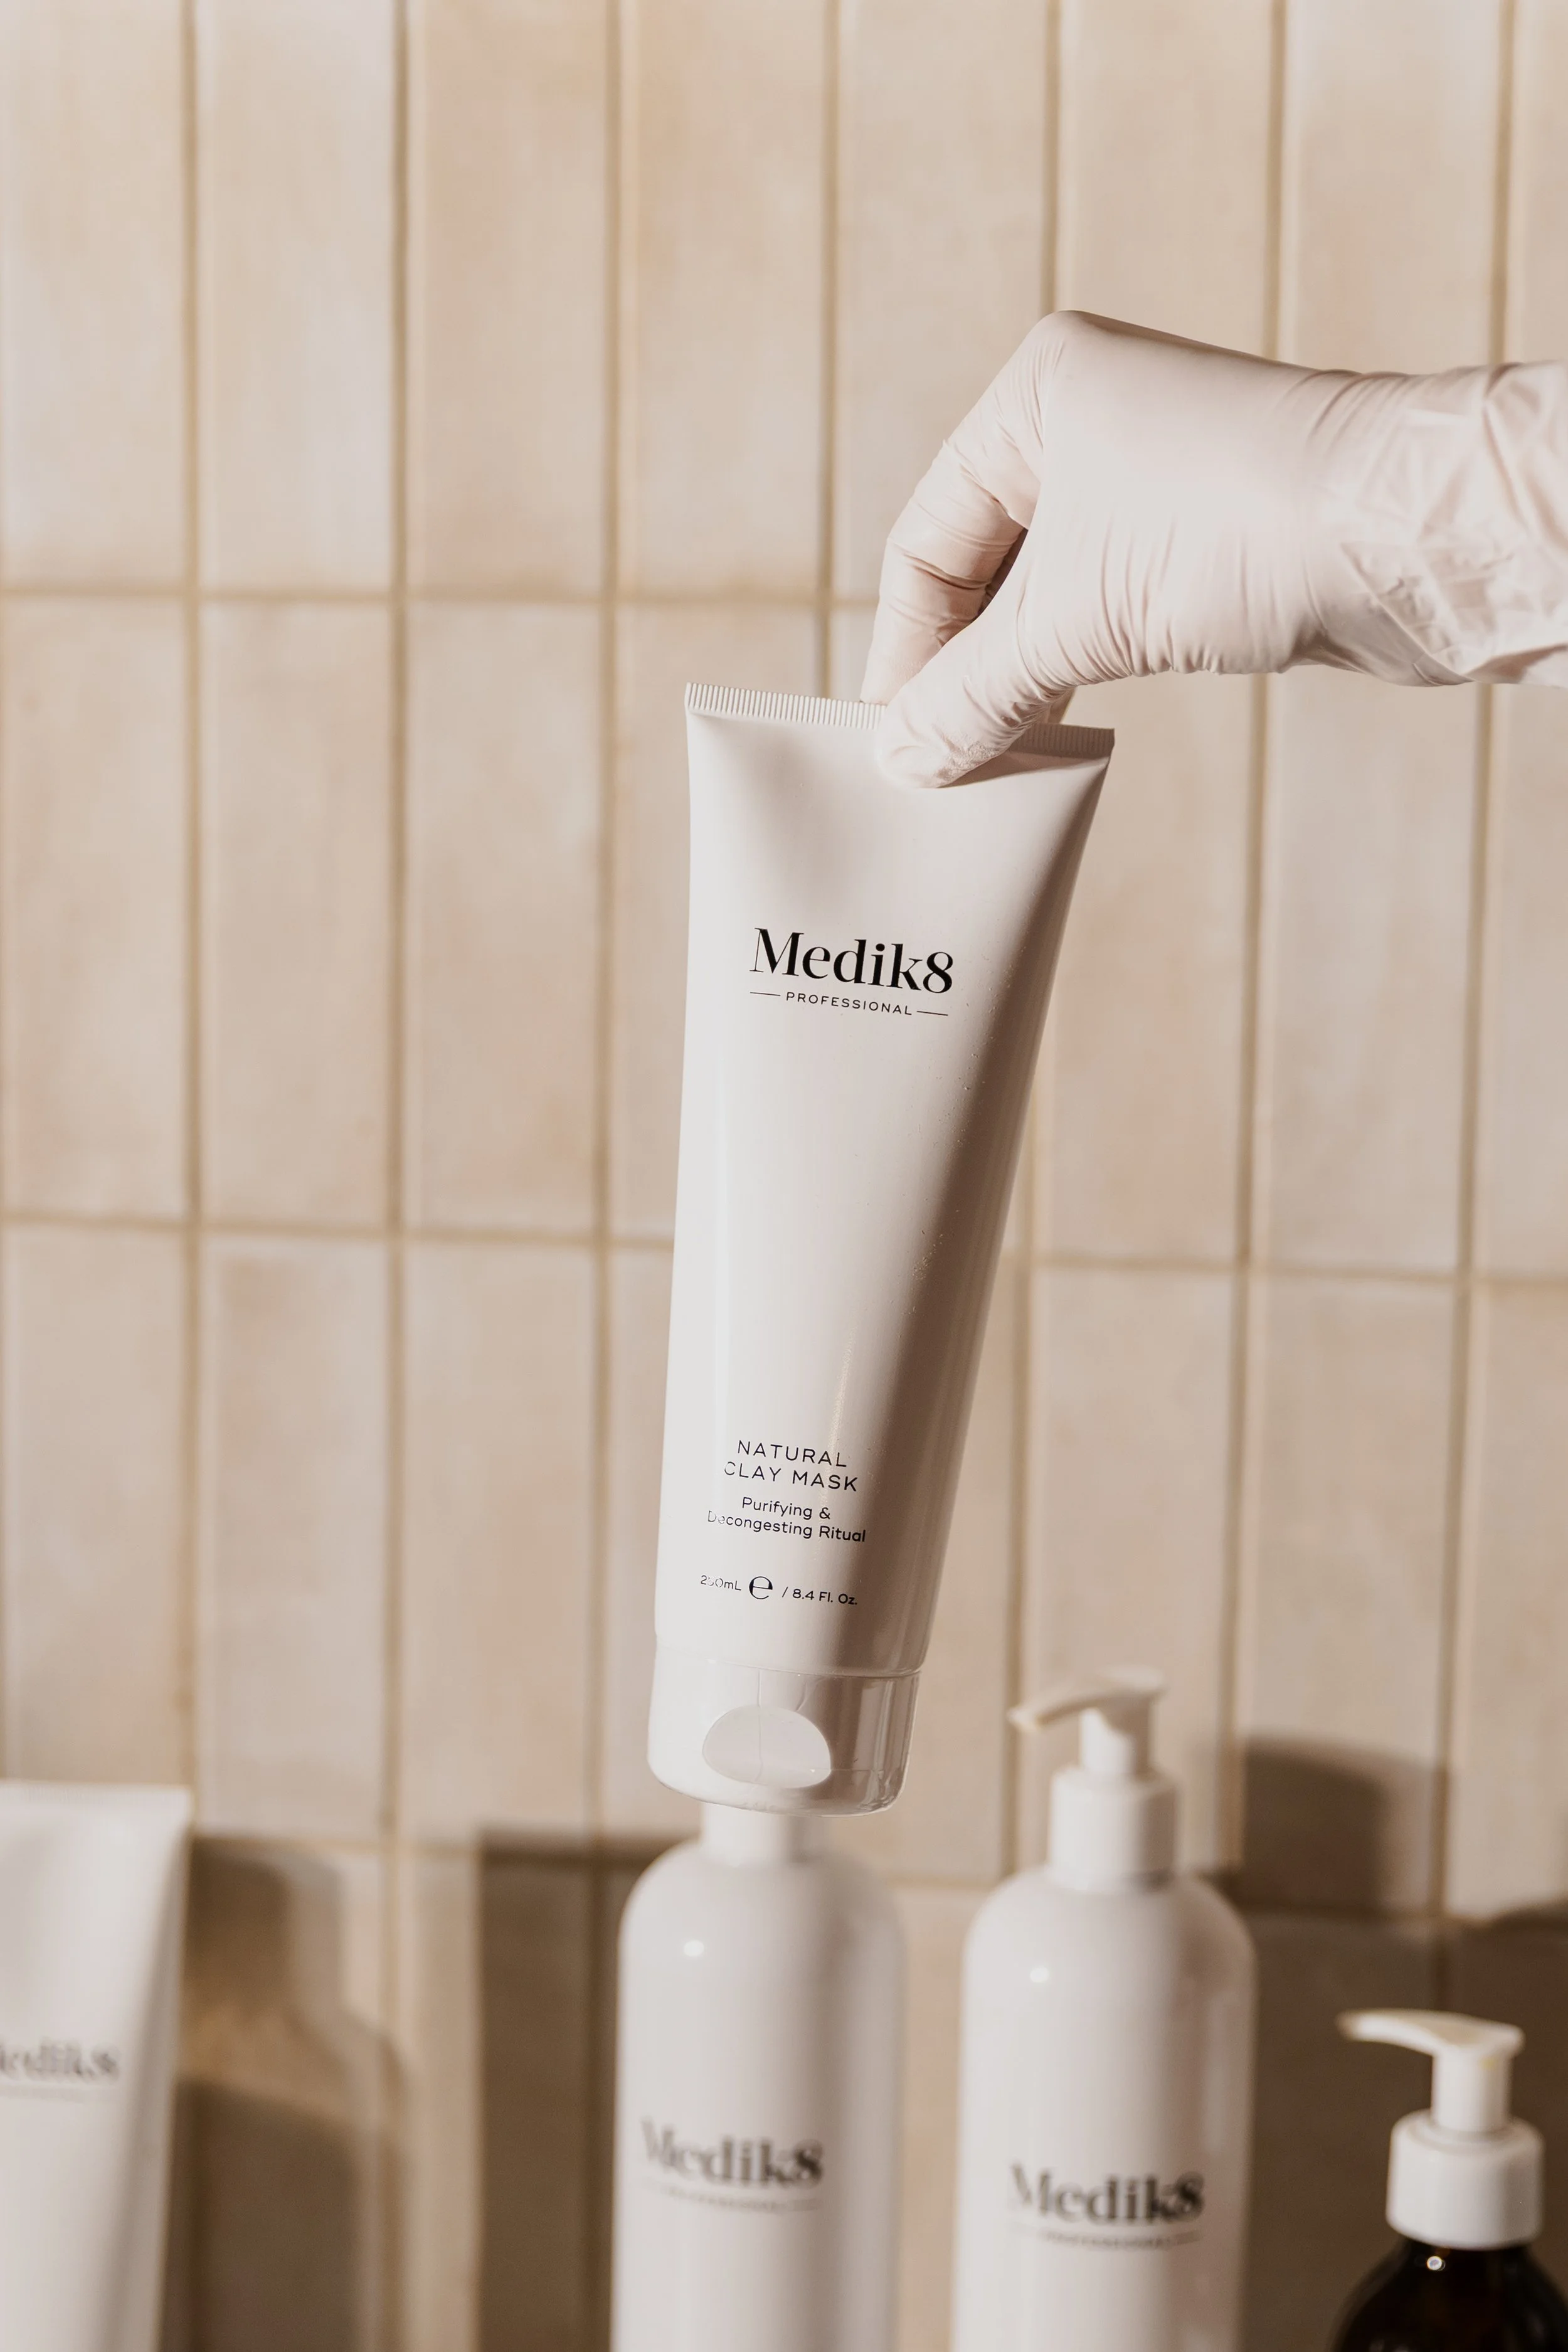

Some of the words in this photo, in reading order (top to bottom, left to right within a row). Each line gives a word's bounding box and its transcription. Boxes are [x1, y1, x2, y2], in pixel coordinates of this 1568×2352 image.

[750, 928, 953, 993] Medik8
[786, 992, 912, 1015] PROFESSIONAL
[738, 1440, 847, 1467] NATURAL
[724, 1461, 781, 1481] CLAY
[792, 1470, 858, 1491] MASK
[742, 1497, 812, 1520] Purifying
[819, 1507, 830, 1520] &
[707, 1510, 812, 1539] Decongesting
[819, 1526, 866, 1542] Ritual
[792, 1589, 814, 1600] 8.4
[819, 1591, 833, 1602] Fl.
[838, 1594, 857, 1605] Oz.
[0, 2038, 119, 2081] edik8
[640, 2117, 824, 2188] Medik8
[1007, 2161, 1204, 2225] Medik8
